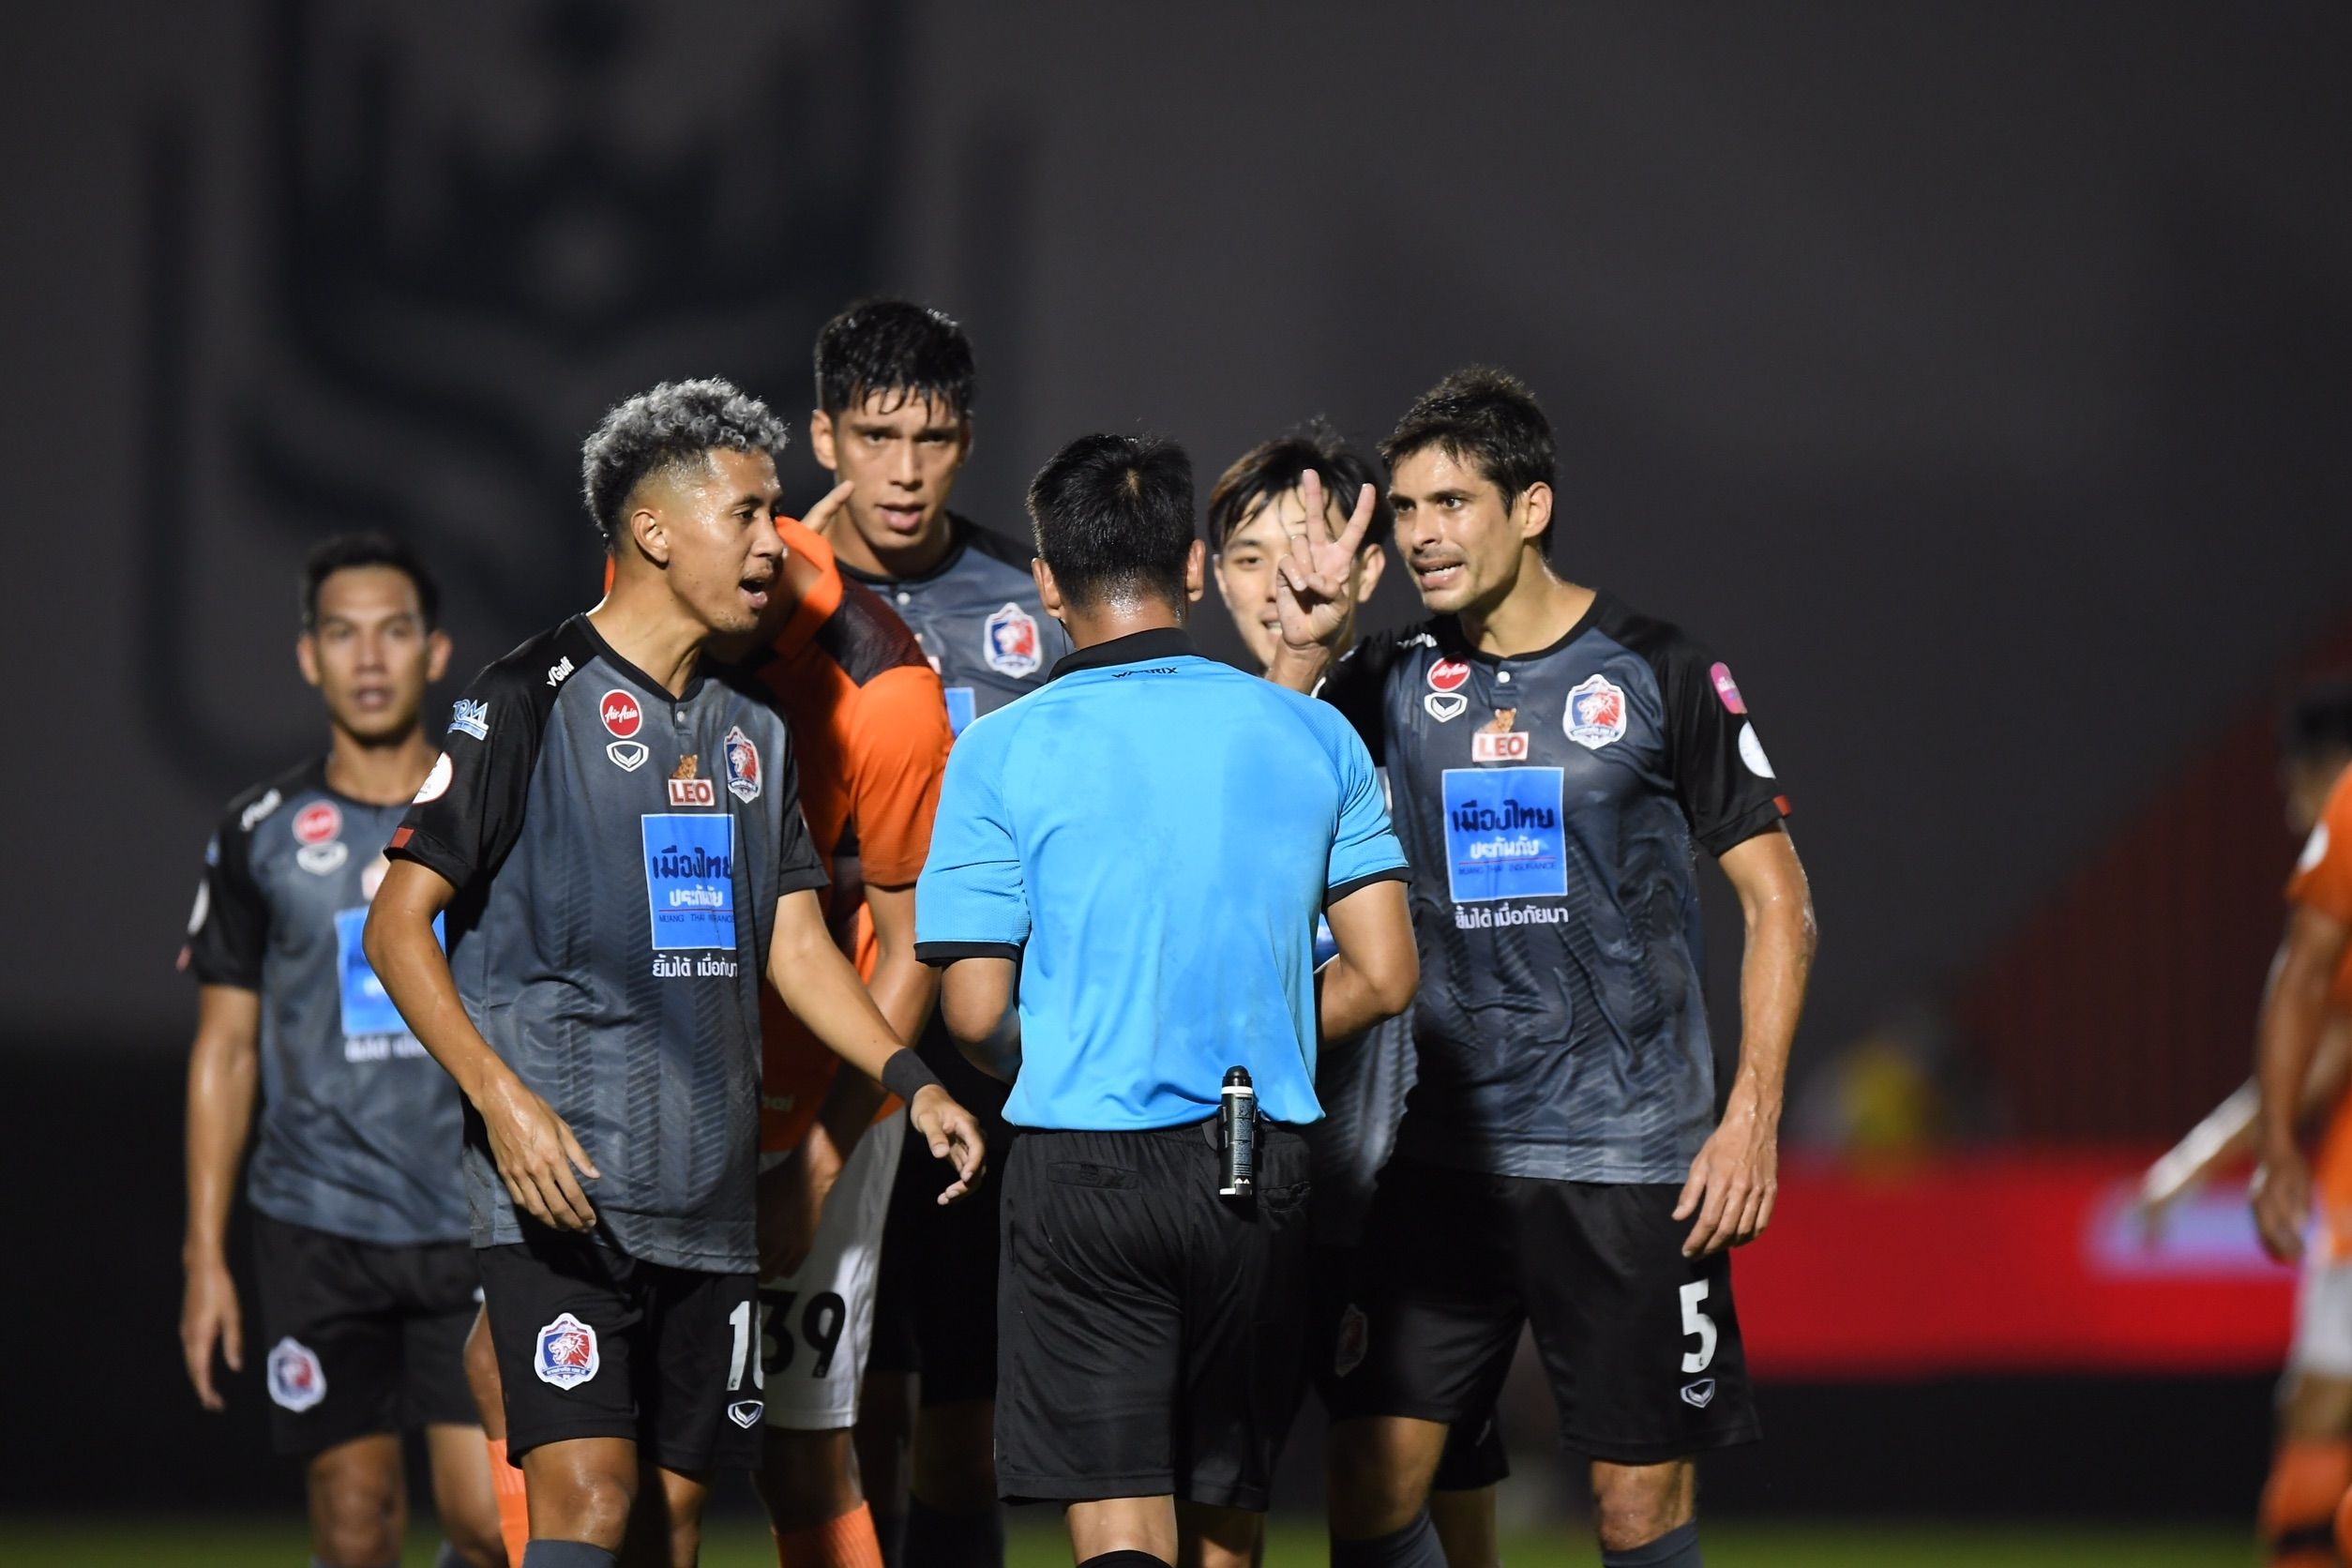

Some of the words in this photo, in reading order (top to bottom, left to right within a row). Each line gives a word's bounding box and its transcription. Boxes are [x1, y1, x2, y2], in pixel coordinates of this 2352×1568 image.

[1478, 736, 1525, 757] LEO
[671, 782, 711, 803] LEO
[652, 954, 691, 977] ยิ้มได้
[757, 1288, 846, 1379] 39
[1680, 1278, 1717, 1373] 5
